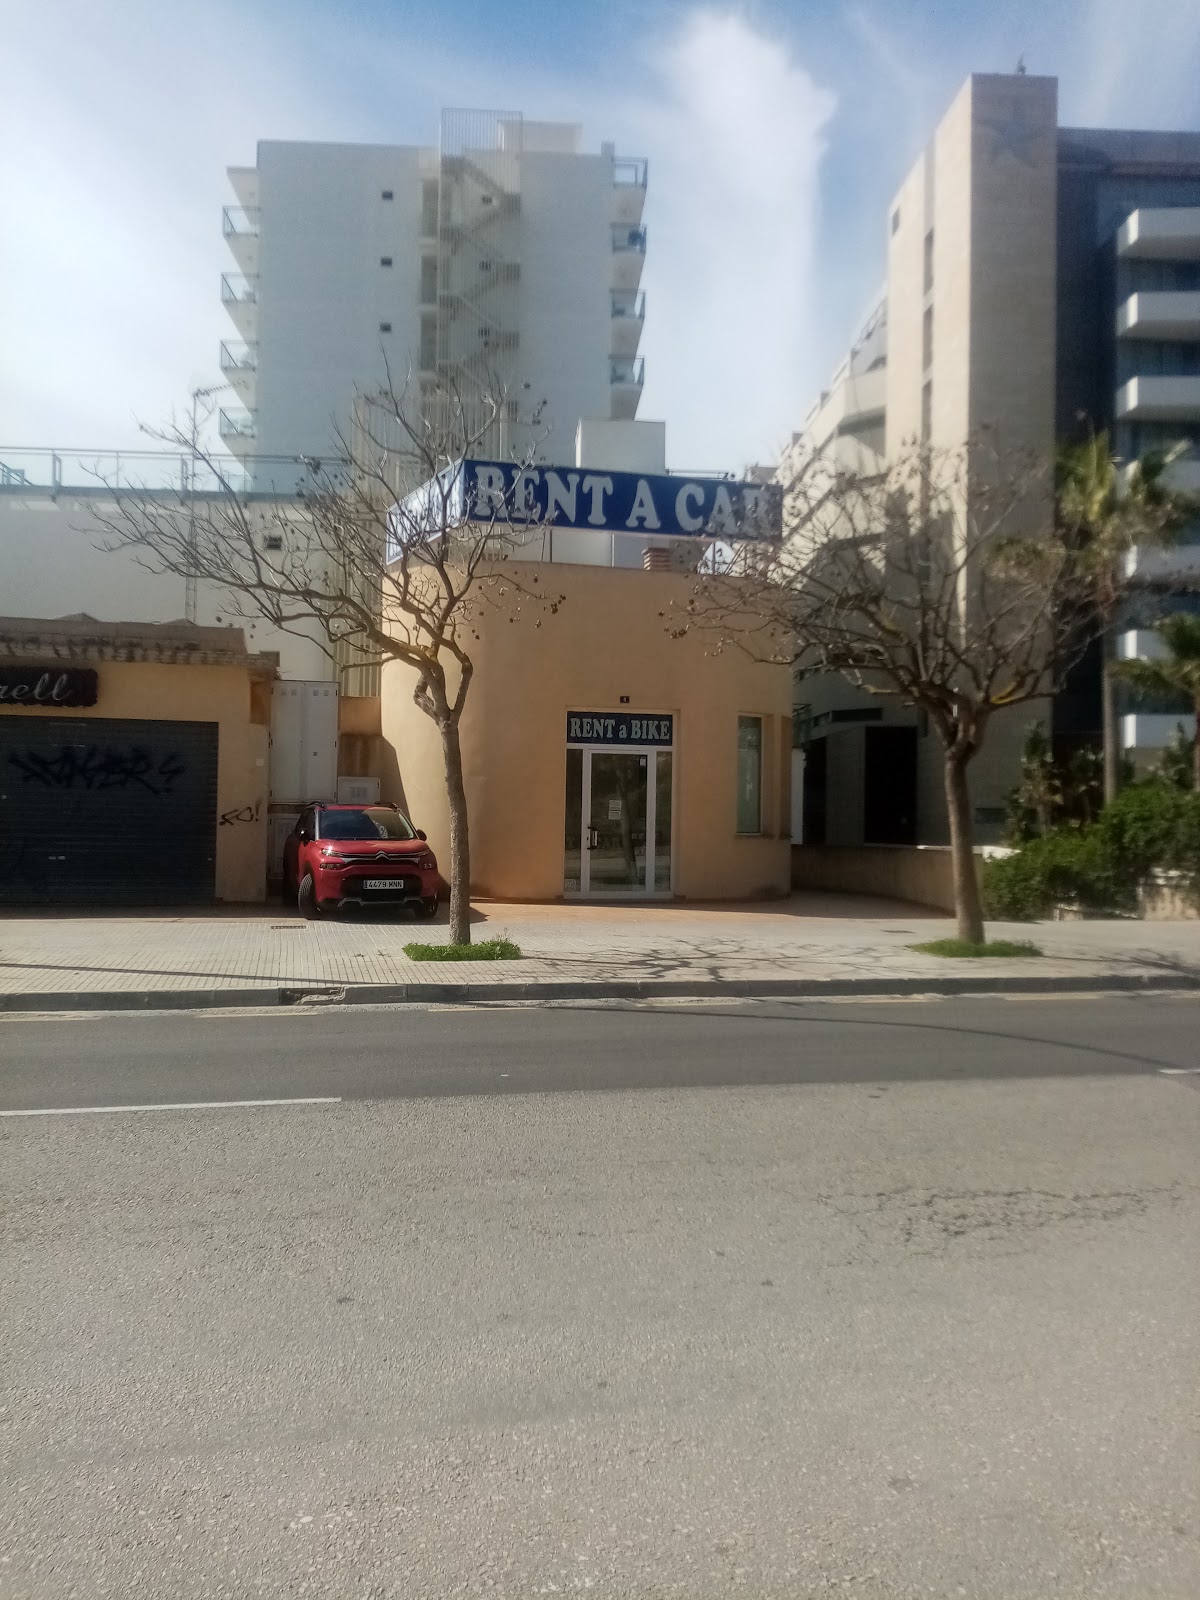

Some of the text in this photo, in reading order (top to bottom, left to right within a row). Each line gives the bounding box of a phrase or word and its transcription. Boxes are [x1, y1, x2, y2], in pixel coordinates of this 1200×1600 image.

[474, 465, 614, 526] RENT
[625, 479, 661, 530] A
[675, 482, 778, 538] CAR
[569, 717, 670, 740] RENT a BIKE
